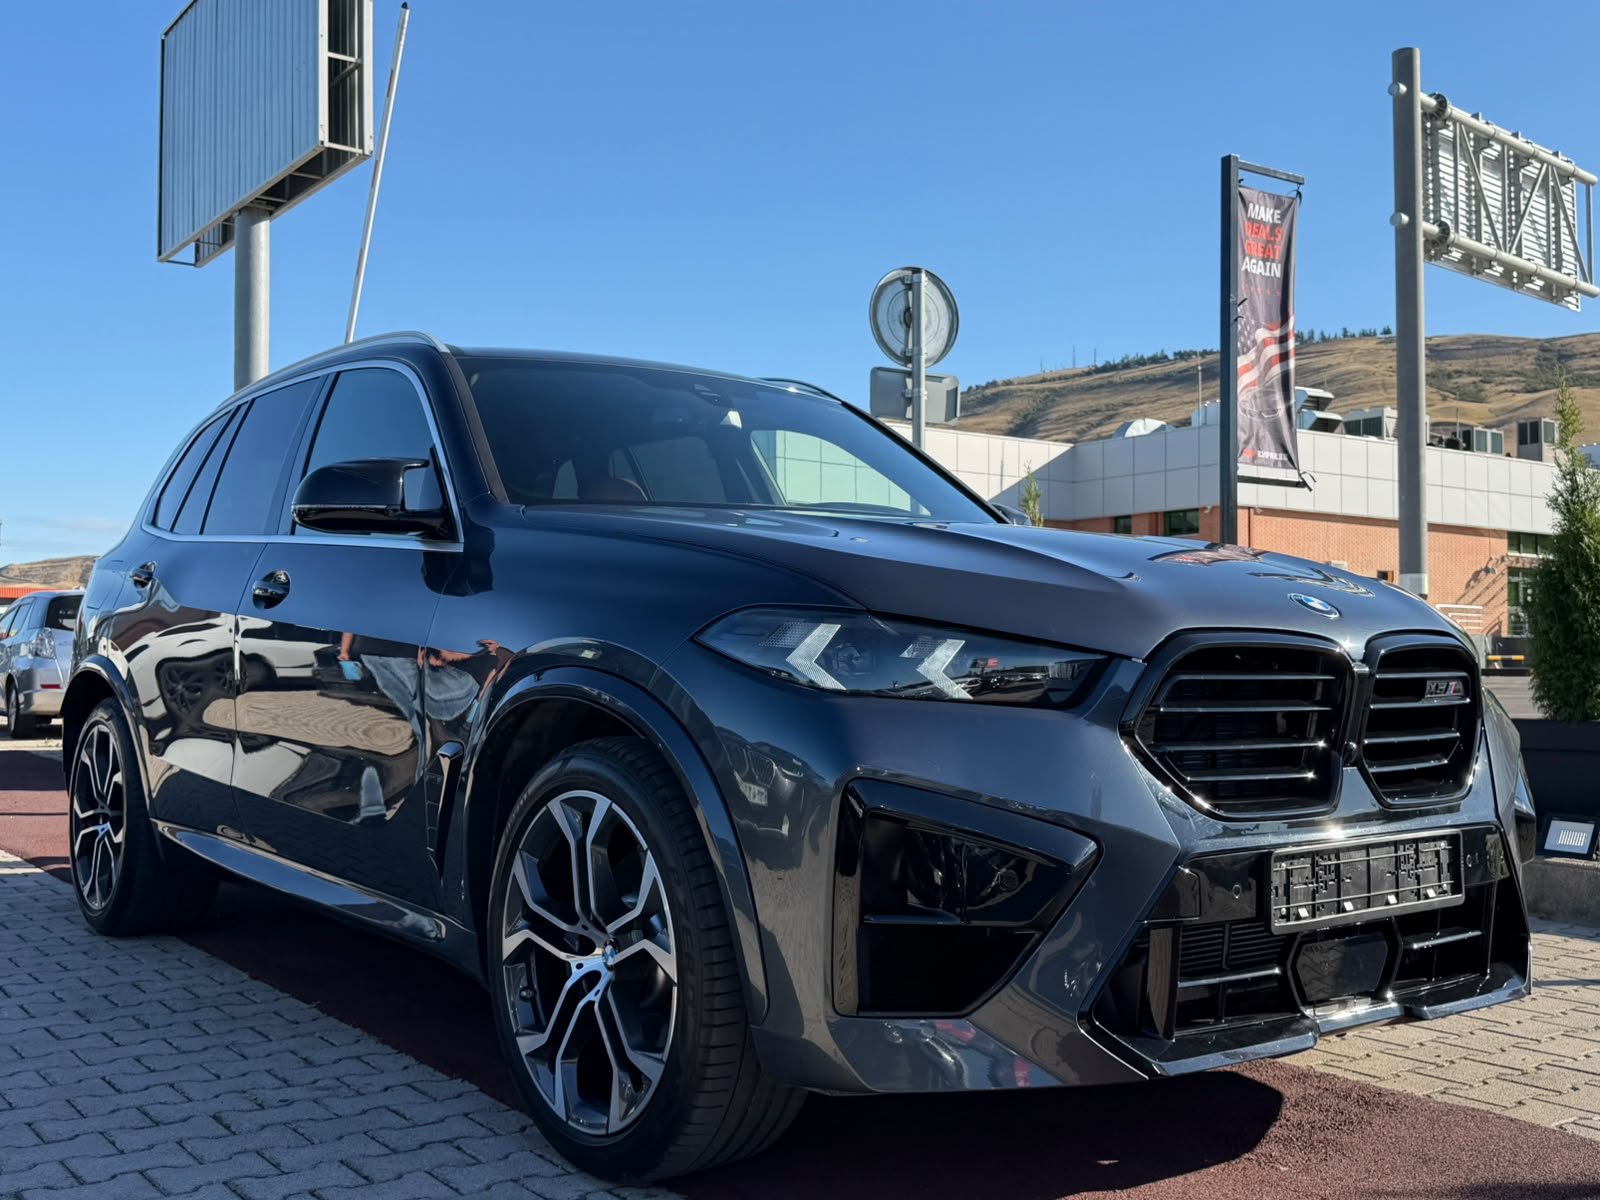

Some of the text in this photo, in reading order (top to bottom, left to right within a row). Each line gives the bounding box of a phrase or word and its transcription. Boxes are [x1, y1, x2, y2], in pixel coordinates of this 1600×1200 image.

[1247, 203, 1281, 223] MAKE
[1245, 221, 1283, 242] DEALS
[1245, 240, 1282, 259] GREAT
[1241, 256, 1281, 278] AGAIN
